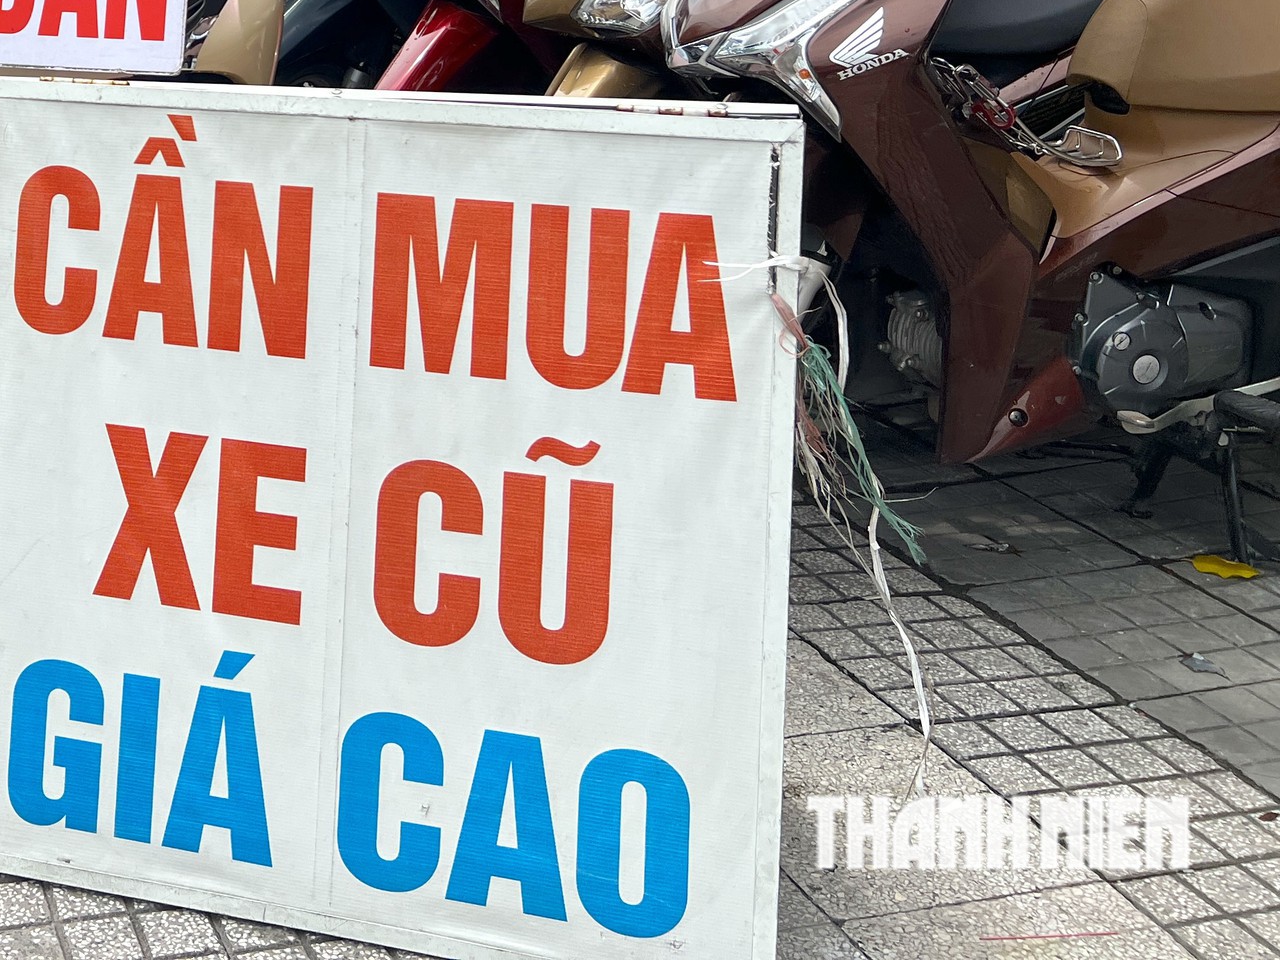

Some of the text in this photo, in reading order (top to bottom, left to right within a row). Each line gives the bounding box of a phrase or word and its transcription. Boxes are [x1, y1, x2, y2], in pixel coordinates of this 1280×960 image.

[836, 47, 910, 81] HONDA
[13, 114, 738, 403] CẦN MUA
[92, 422, 616, 666] XE CŨ
[7, 649, 692, 939] GIÁ CAO
